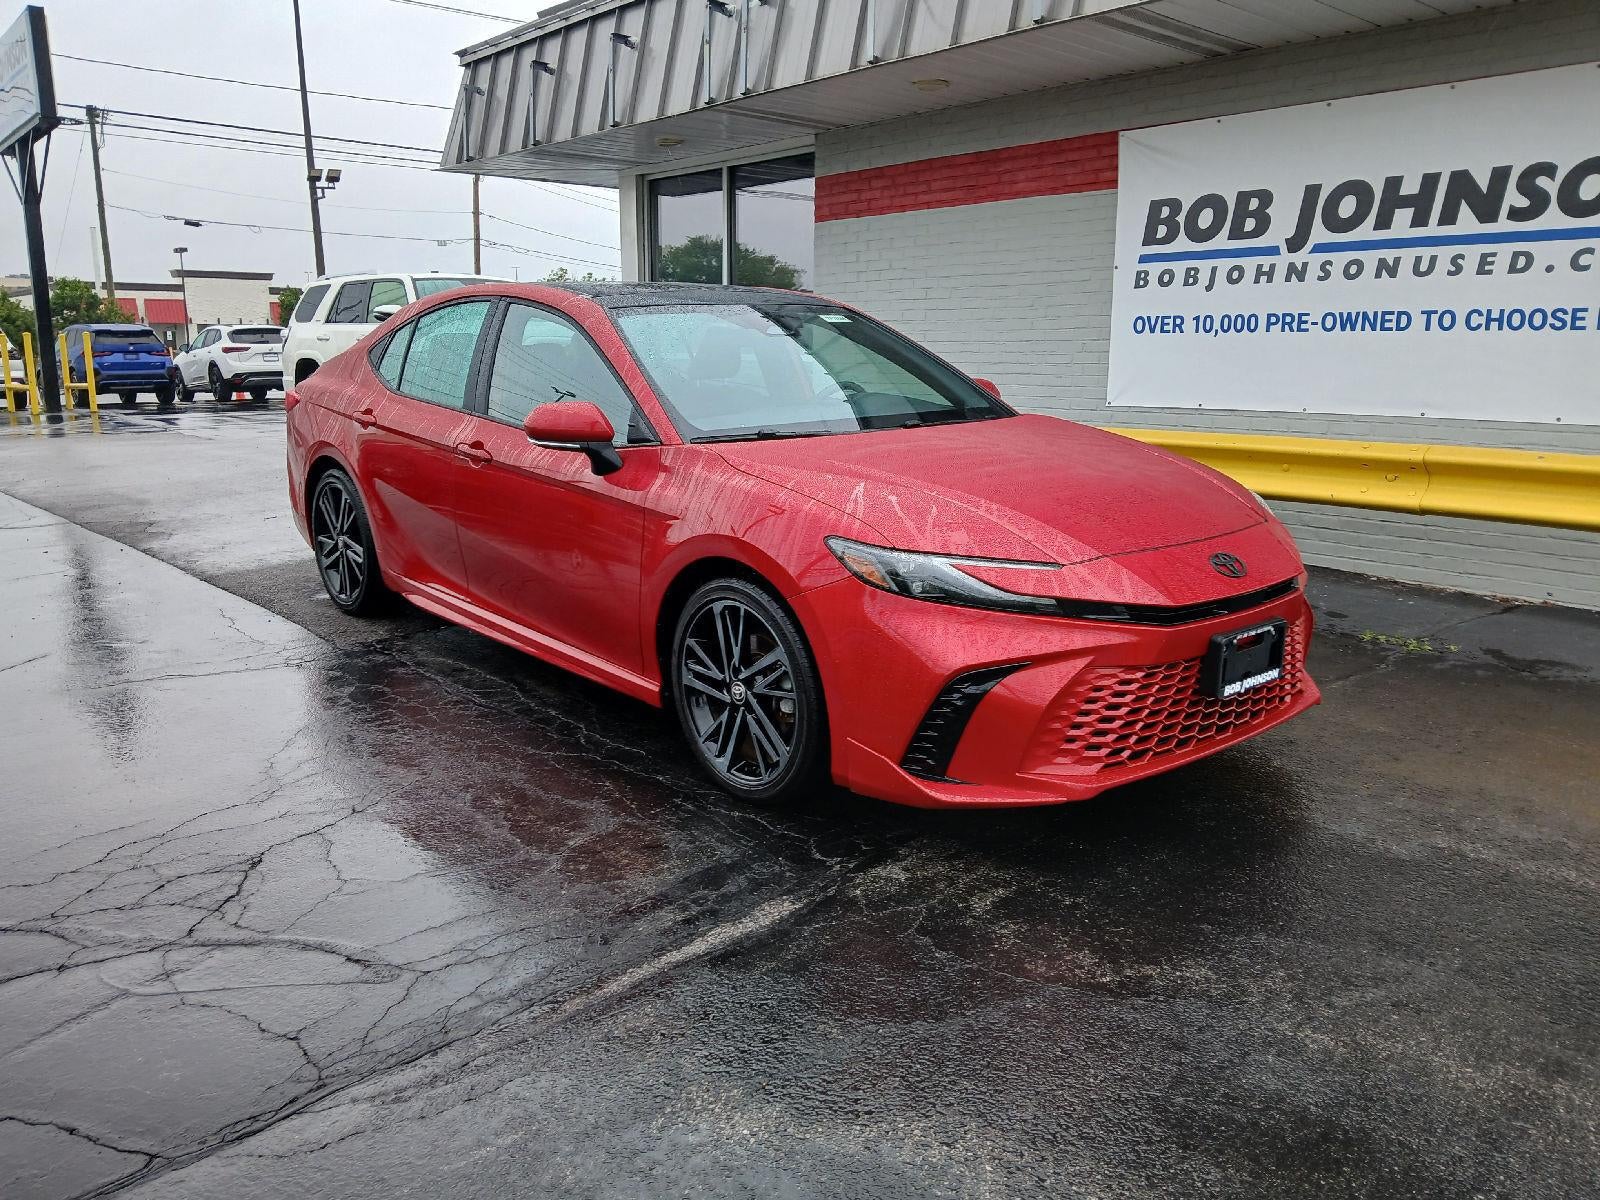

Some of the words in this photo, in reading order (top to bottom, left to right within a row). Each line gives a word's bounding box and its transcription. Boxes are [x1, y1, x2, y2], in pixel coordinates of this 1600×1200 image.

[1142, 188, 1274, 247] BOB
[1132, 315, 1186, 335] OVER
[1192, 313, 1259, 337] 10,000
[1265, 310, 1412, 333] PRE-OWNED
[1420, 309, 1457, 332] TO
[1464, 307, 1589, 331] CHOOSE
[1223, 681, 1242, 697] BOB
[1240, 667, 1280, 693] JOHNSON
